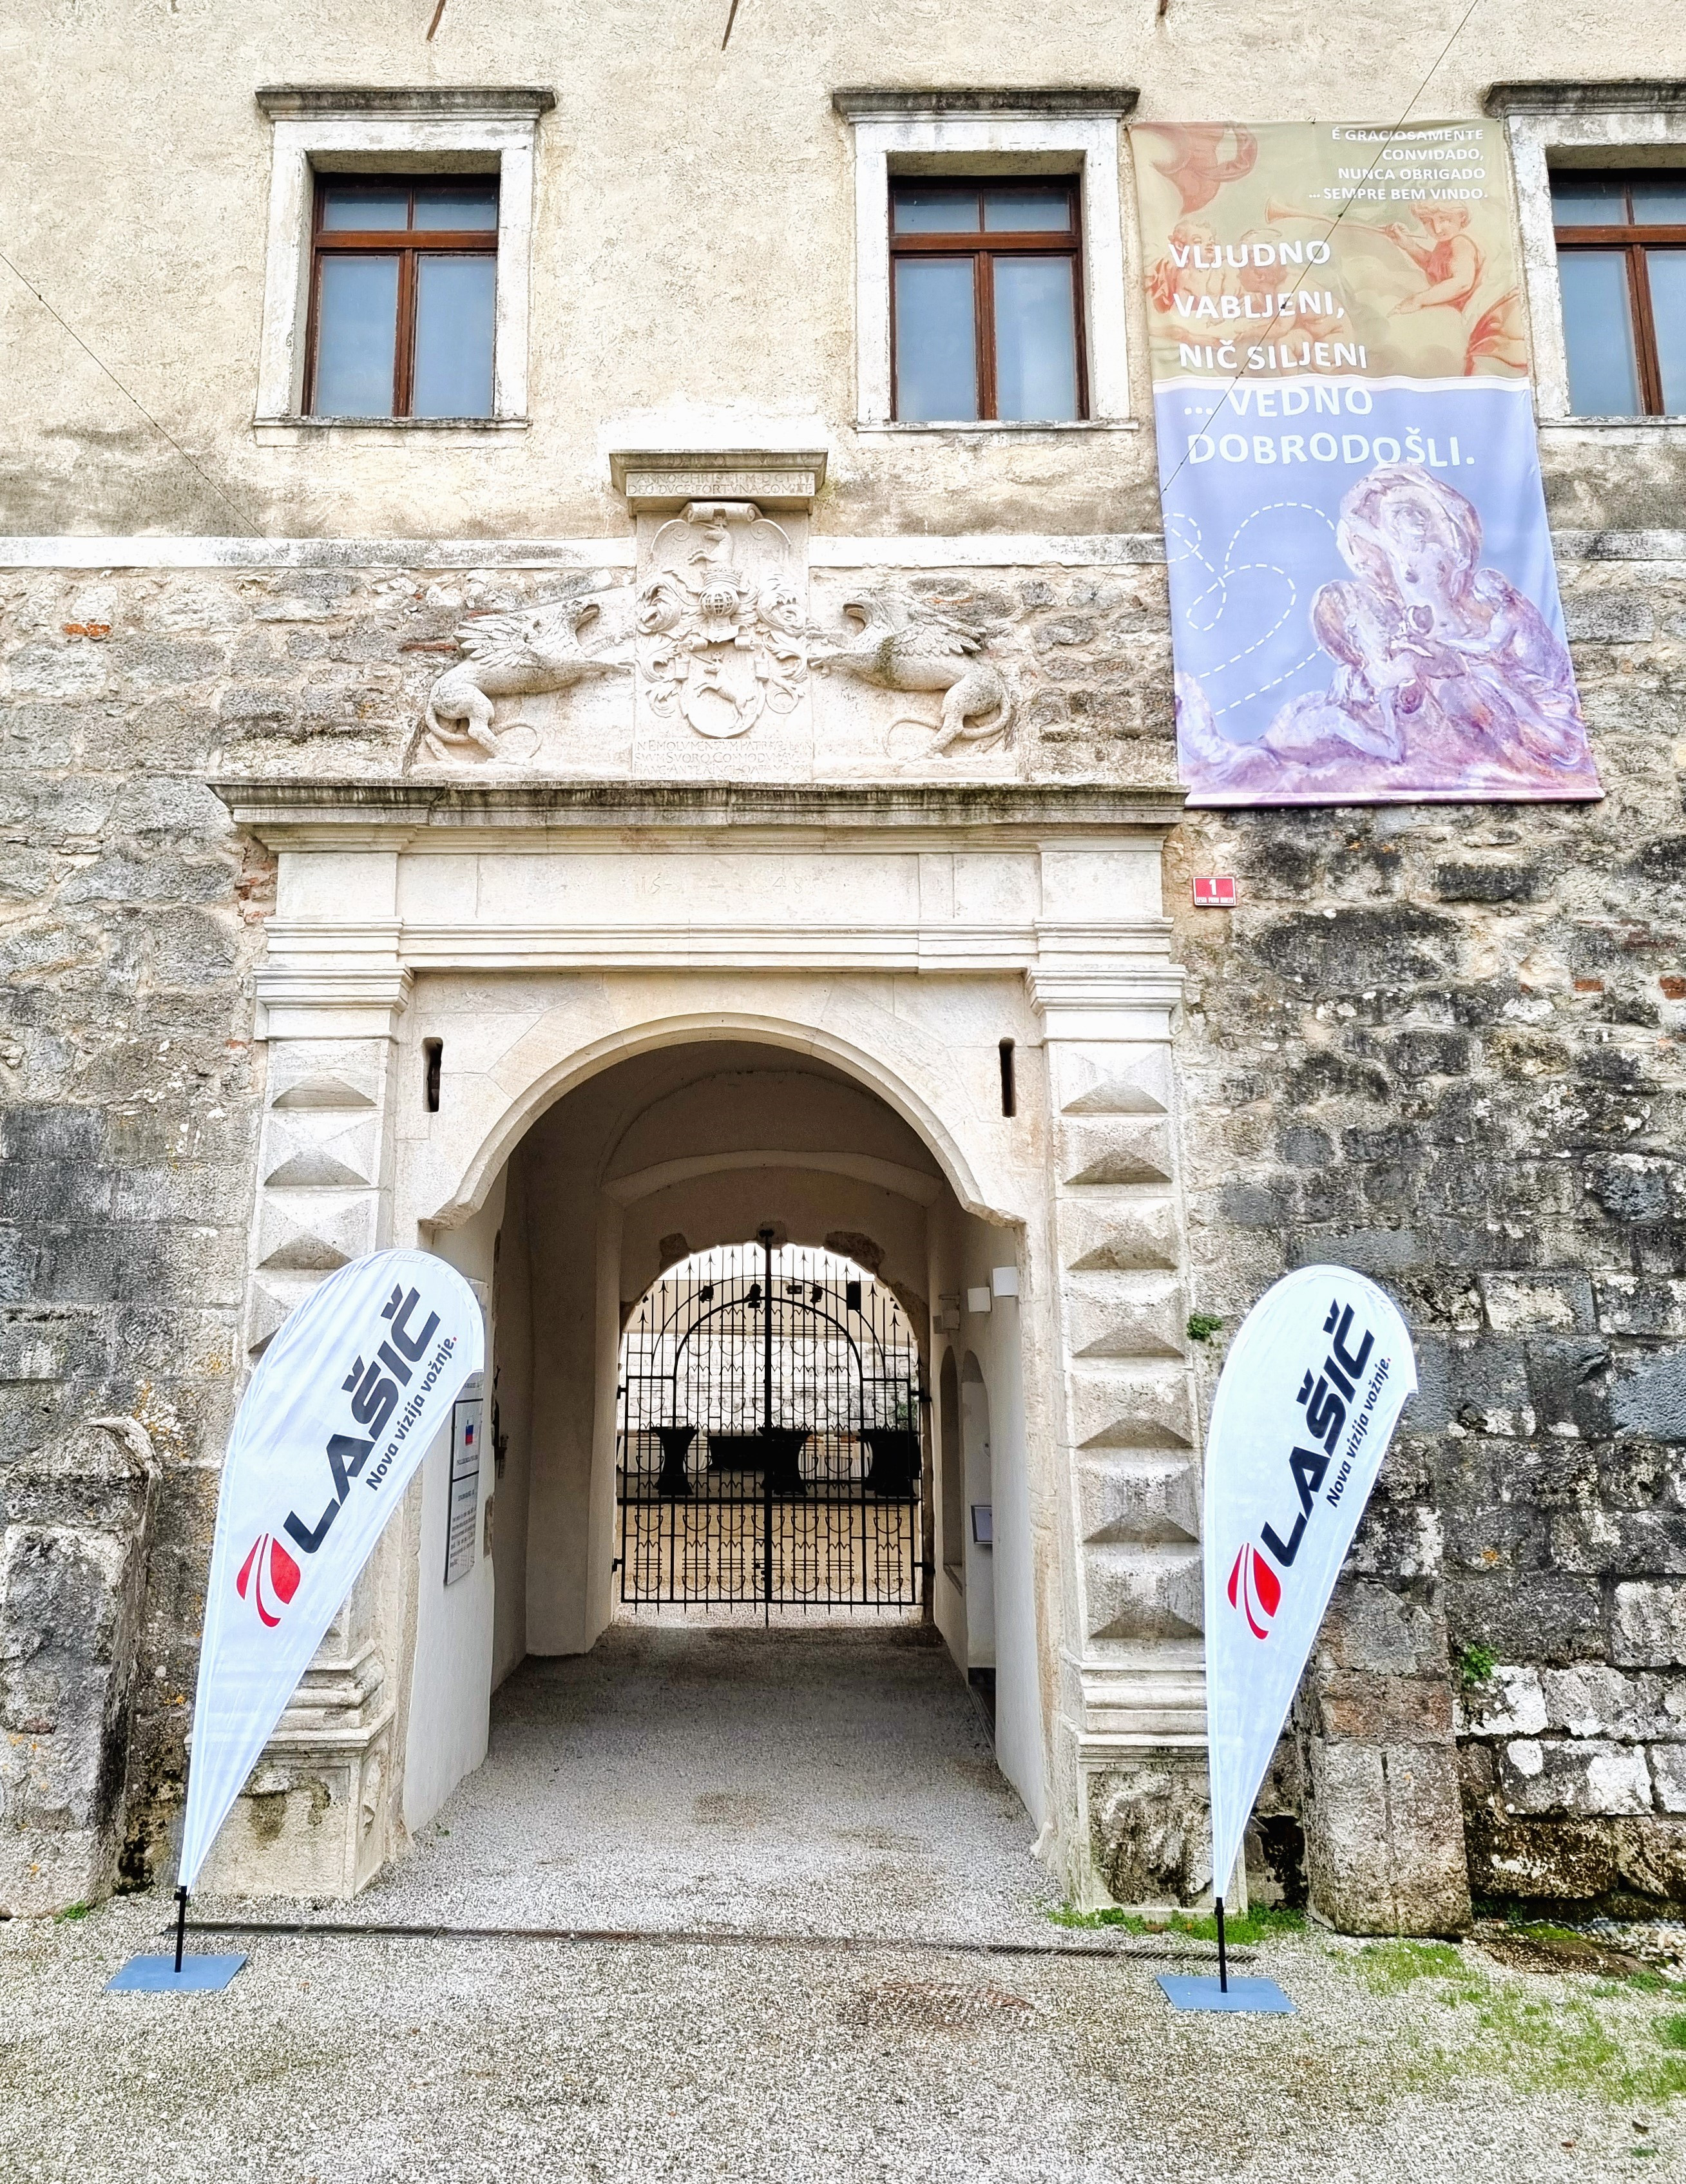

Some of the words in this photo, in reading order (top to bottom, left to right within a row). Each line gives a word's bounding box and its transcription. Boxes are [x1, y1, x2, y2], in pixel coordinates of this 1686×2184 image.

[1332, 127, 1341, 140] É
[1345, 128, 1484, 141] GRACIOSAMENTE
[1383, 148, 1484, 162] CONVIDADO,
[1338, 168, 1395, 180] NUNCA
[1399, 168, 1486, 180] OBRIGADO
[1391, 189, 1426, 200] BEM
[1430, 188, 1488, 200] VINDO.
[1169, 240, 1331, 269] VLJUDNO
[1173, 290, 1345, 320] VABLJENI,
[1180, 340, 1238, 370] NIČ
[1248, 342, 1368, 370] SILJENI
[1228, 386, 1374, 417] VEDNO
[1187, 426, 1475, 468] DOBRODOŠLI.
[1209, 879, 1217, 896] 1
[283, 1283, 441, 1554] LAŠIČ
[366, 1443, 399, 1491] Nova
[395, 1394, 425, 1440] vizija
[421, 1337, 457, 1392] vožnje.
[1260, 1298, 1375, 1567] LAŠIČ
[1326, 1460, 1352, 1508] Nova
[1346, 1413, 1369, 1458] vizija
[1364, 1357, 1391, 1411] vožnje.
